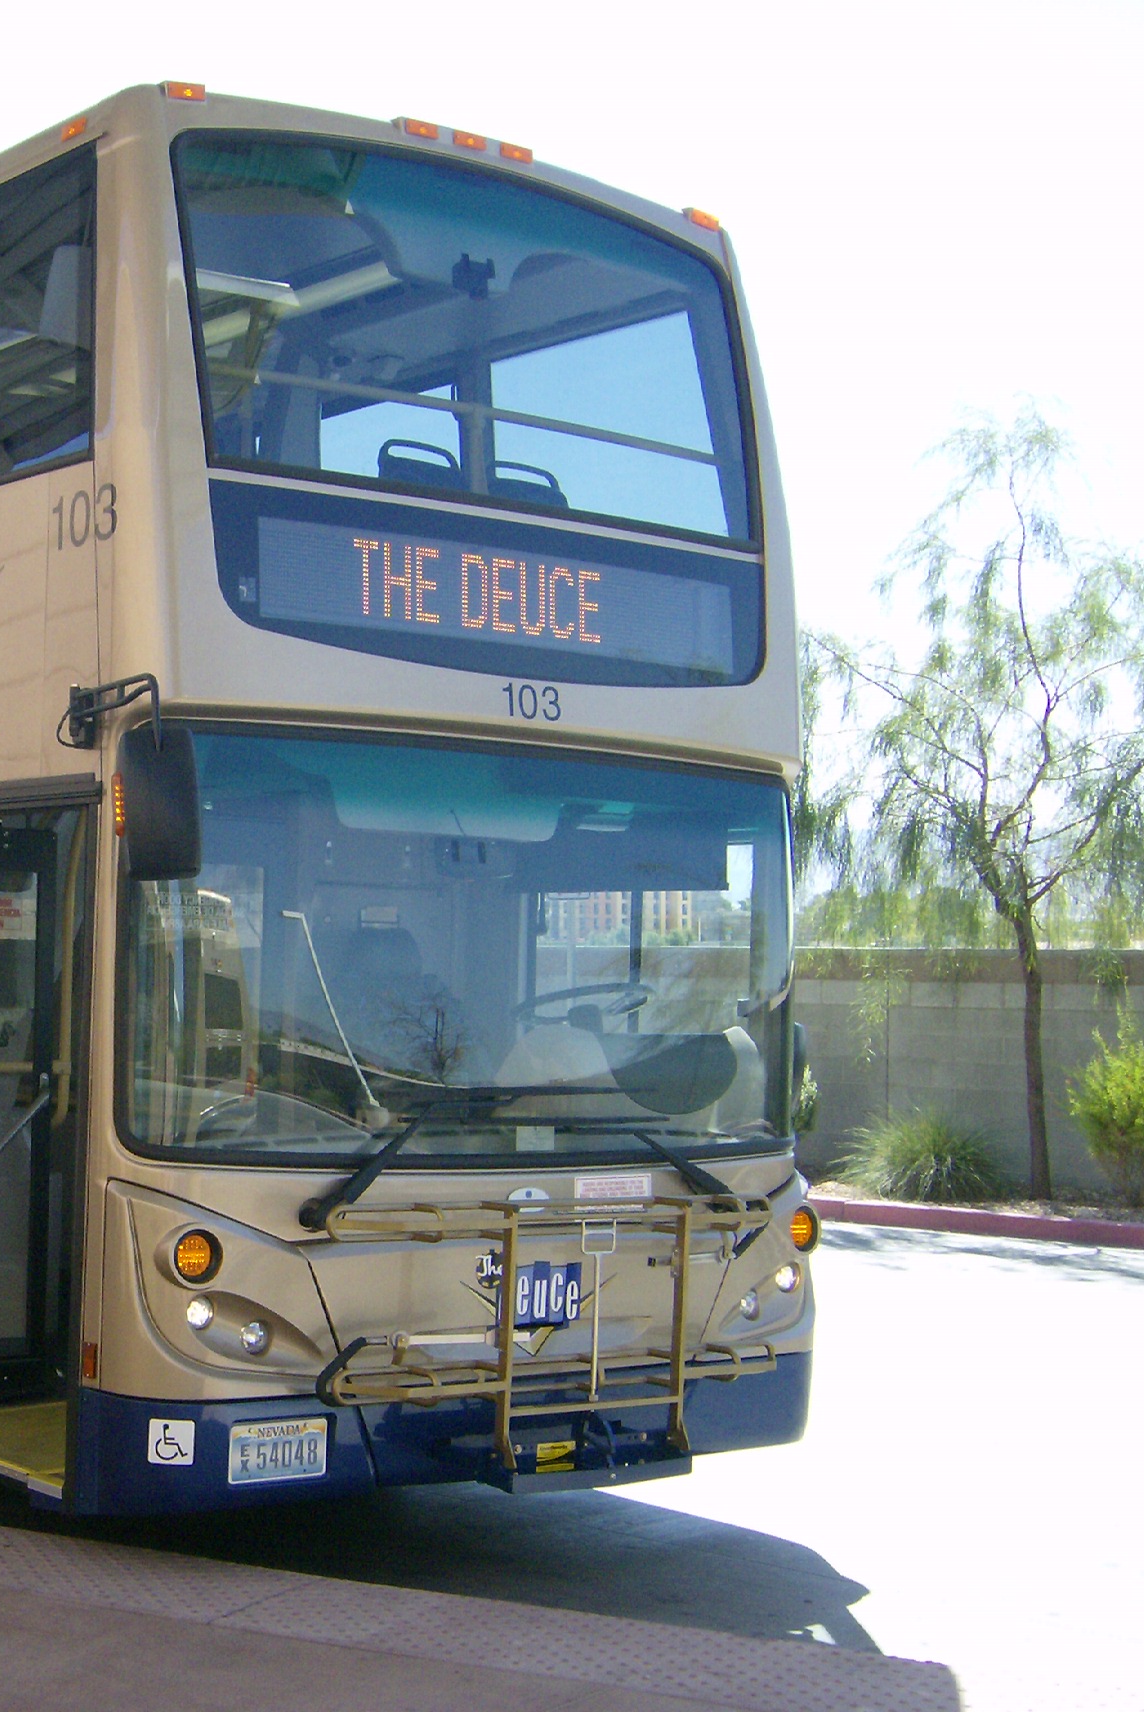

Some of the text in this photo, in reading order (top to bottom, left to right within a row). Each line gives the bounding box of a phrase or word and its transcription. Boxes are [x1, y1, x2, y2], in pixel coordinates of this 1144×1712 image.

[52, 483, 118, 550] 103
[353, 538, 602, 644] THE DEUCE
[501, 682, 562, 722] 103
[498, 1273, 579, 1320] euce
[256, 1424, 301, 1438] NEVADA
[256, 1438, 318, 1470] 54048
